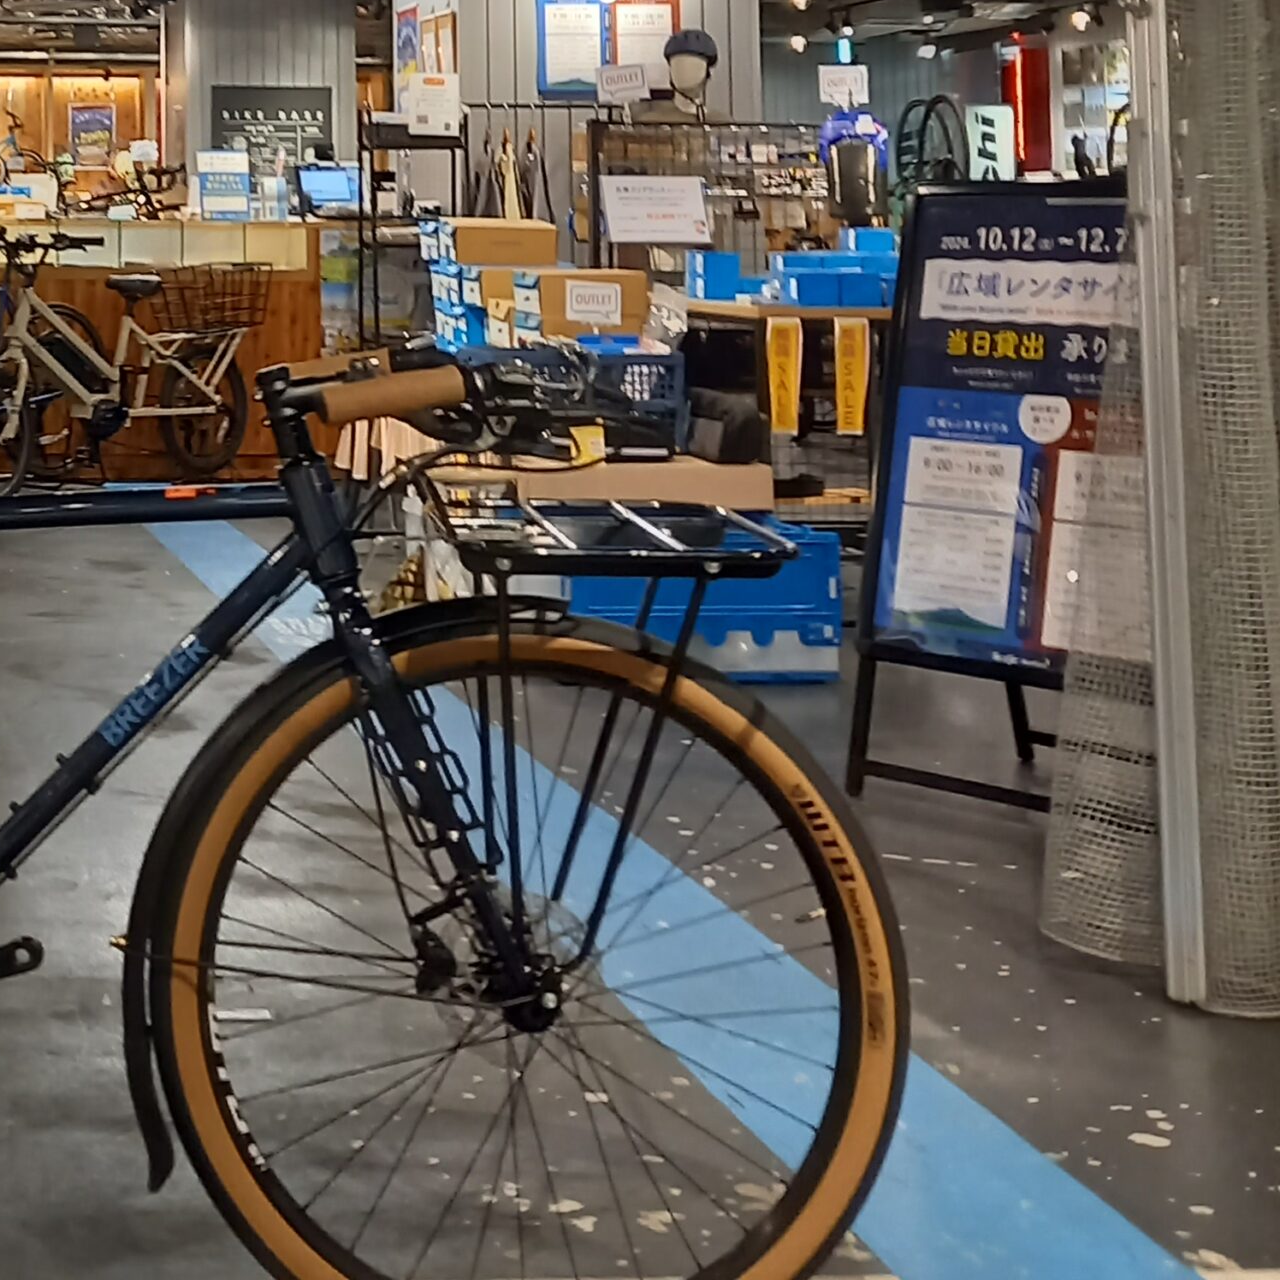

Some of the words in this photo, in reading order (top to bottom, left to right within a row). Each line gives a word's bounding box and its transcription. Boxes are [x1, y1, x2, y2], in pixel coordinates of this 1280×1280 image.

[575, 294, 613, 307] OUTLET
[946, 328, 1045, 361] 当日貸出
[98, 637, 211, 747] BREEZER
